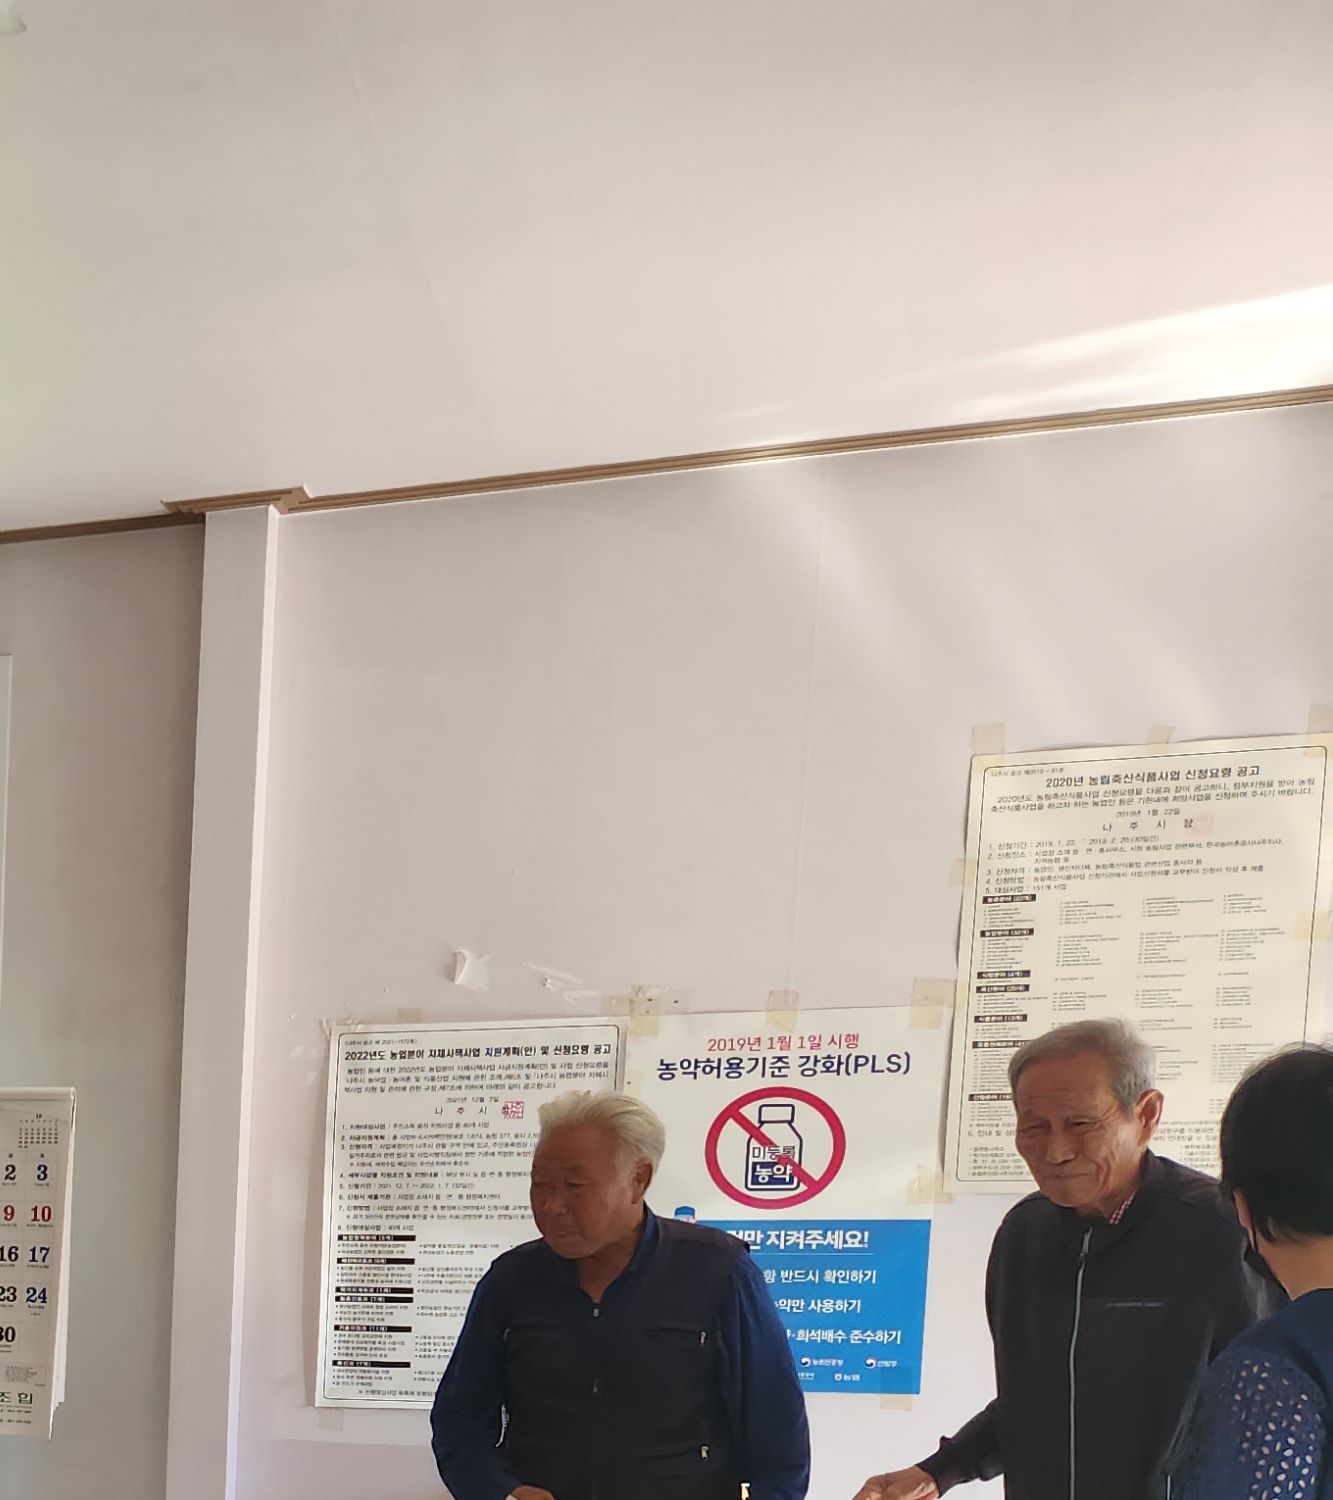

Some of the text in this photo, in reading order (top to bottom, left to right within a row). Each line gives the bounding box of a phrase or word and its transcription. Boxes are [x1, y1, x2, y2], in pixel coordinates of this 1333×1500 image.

[1046, 777, 1084, 788] 2020년
[1185, 767, 1232, 781] 신청요령
[1237, 765, 1260, 777] 공고
[707, 1033, 860, 1052] 2019년 1월 1일 시행
[344, 1050, 386, 1061] 2022년도
[390, 1049, 425, 1060] 농업분야
[540, 1045, 549, 1056] 및
[553, 1044, 589, 1056] 신청요령
[593, 1043, 611, 1055] 공고
[657, 1051, 911, 1081] 농약허용기준 강화(PLS)
[435, 1106, 487, 1116] 나 주 시
[4, 1164, 16, 1181] 2
[37, 1164, 48, 1181] 3
[754, 1164, 794, 1183] 농약
[3, 1205, 15, 1222] 9
[31, 1205, 53, 1222] 10
[766, 1230, 869, 1250] 지켜주세요!
[28, 1246, 51, 1264] 17
[780, 1269, 819, 1284] 반드시
[823, 1269, 877, 1284] 확인하기
[26, 1287, 48, 1304] 24
[775, 1298, 861, 1313] 약만 사용하기
[849, 1330, 901, 1344] 준수하기
